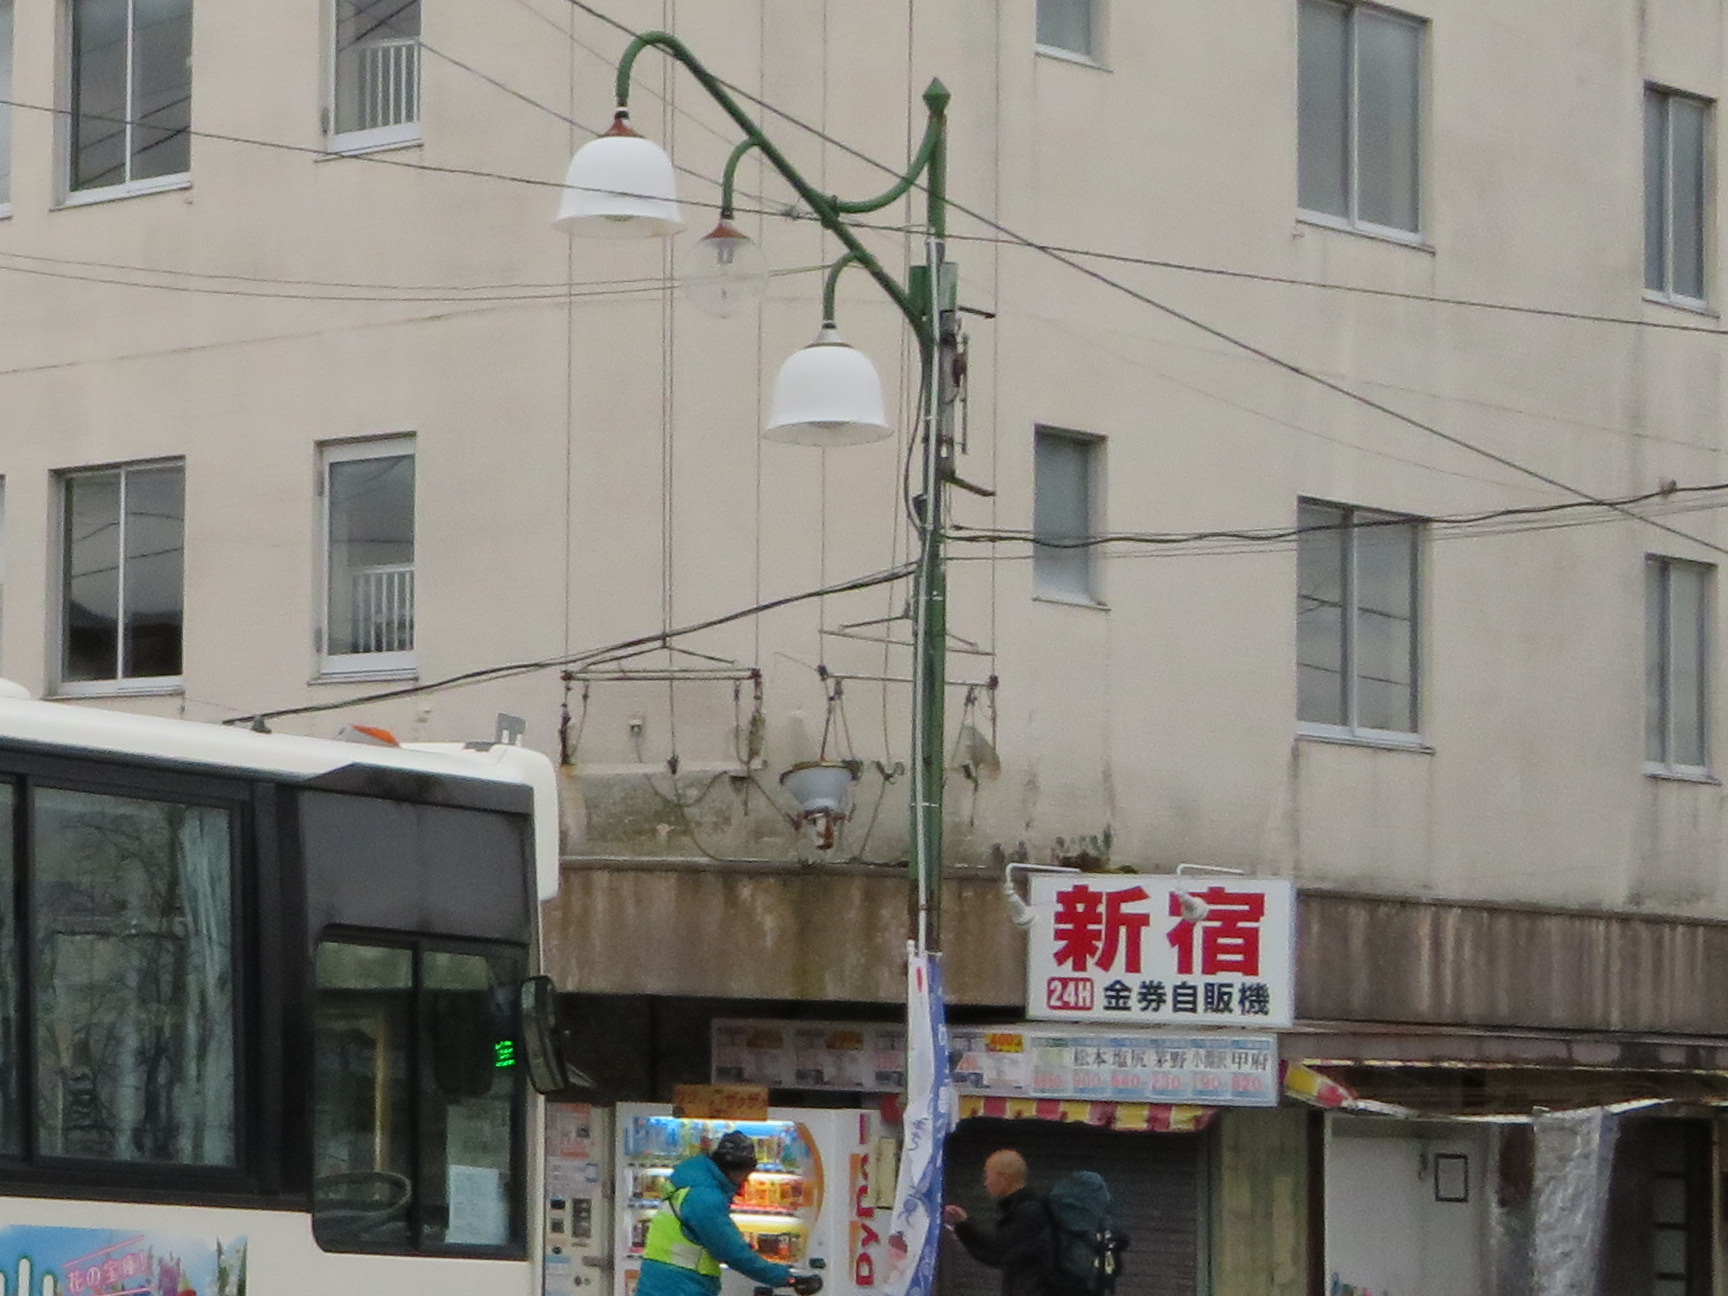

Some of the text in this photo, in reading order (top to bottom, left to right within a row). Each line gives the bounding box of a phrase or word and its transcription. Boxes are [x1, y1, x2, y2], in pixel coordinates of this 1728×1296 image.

[1052, 885, 1267, 976] 新宿
[1049, 980, 1270, 1016] 24H 金券自販機
